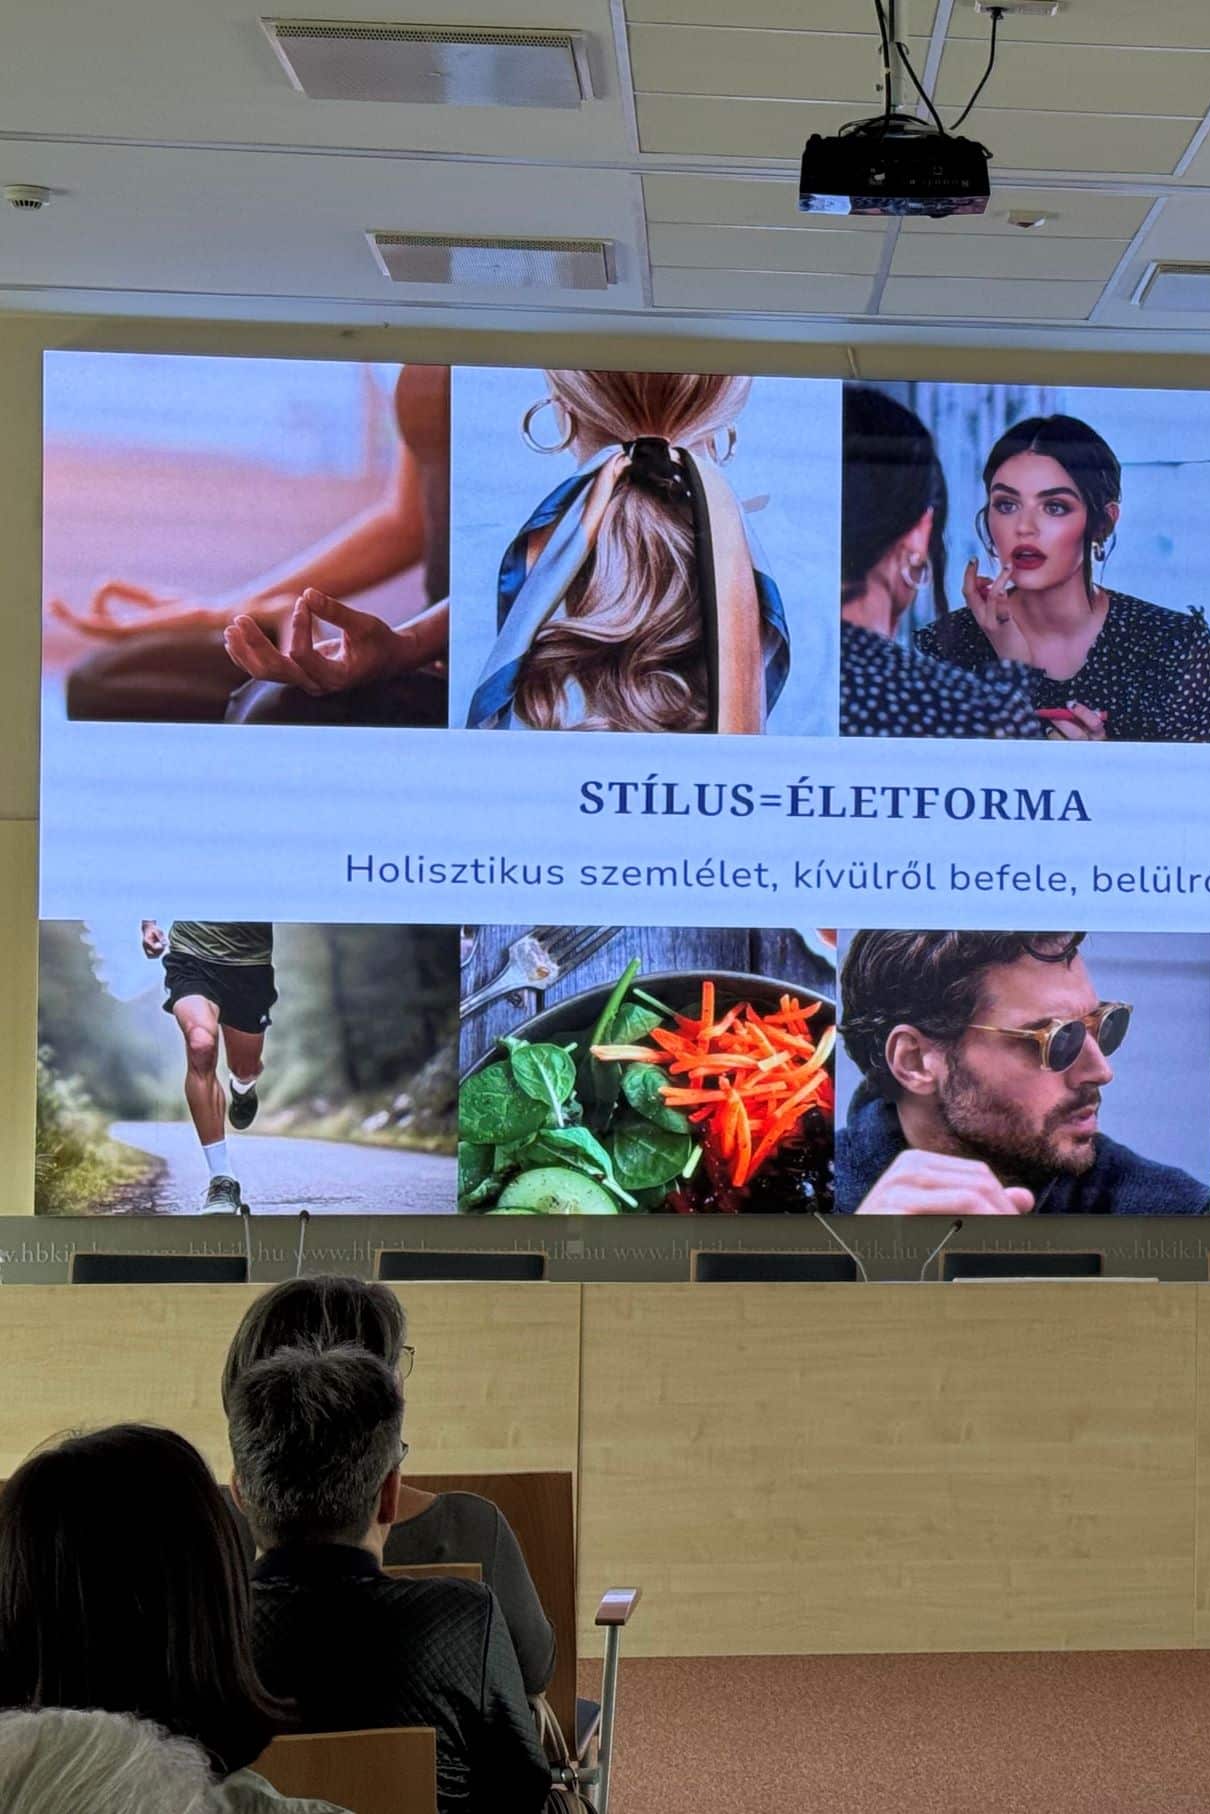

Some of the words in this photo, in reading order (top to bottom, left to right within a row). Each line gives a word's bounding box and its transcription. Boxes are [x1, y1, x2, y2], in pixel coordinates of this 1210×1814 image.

[579, 772, 1093, 822] STÍLUS=ÉLETFORMA
[346, 853, 565, 887] Holisztikus
[579, 856, 778, 893] szemlélet,
[794, 858, 937, 891] kívülről
[950, 862, 1077, 897] befele,
